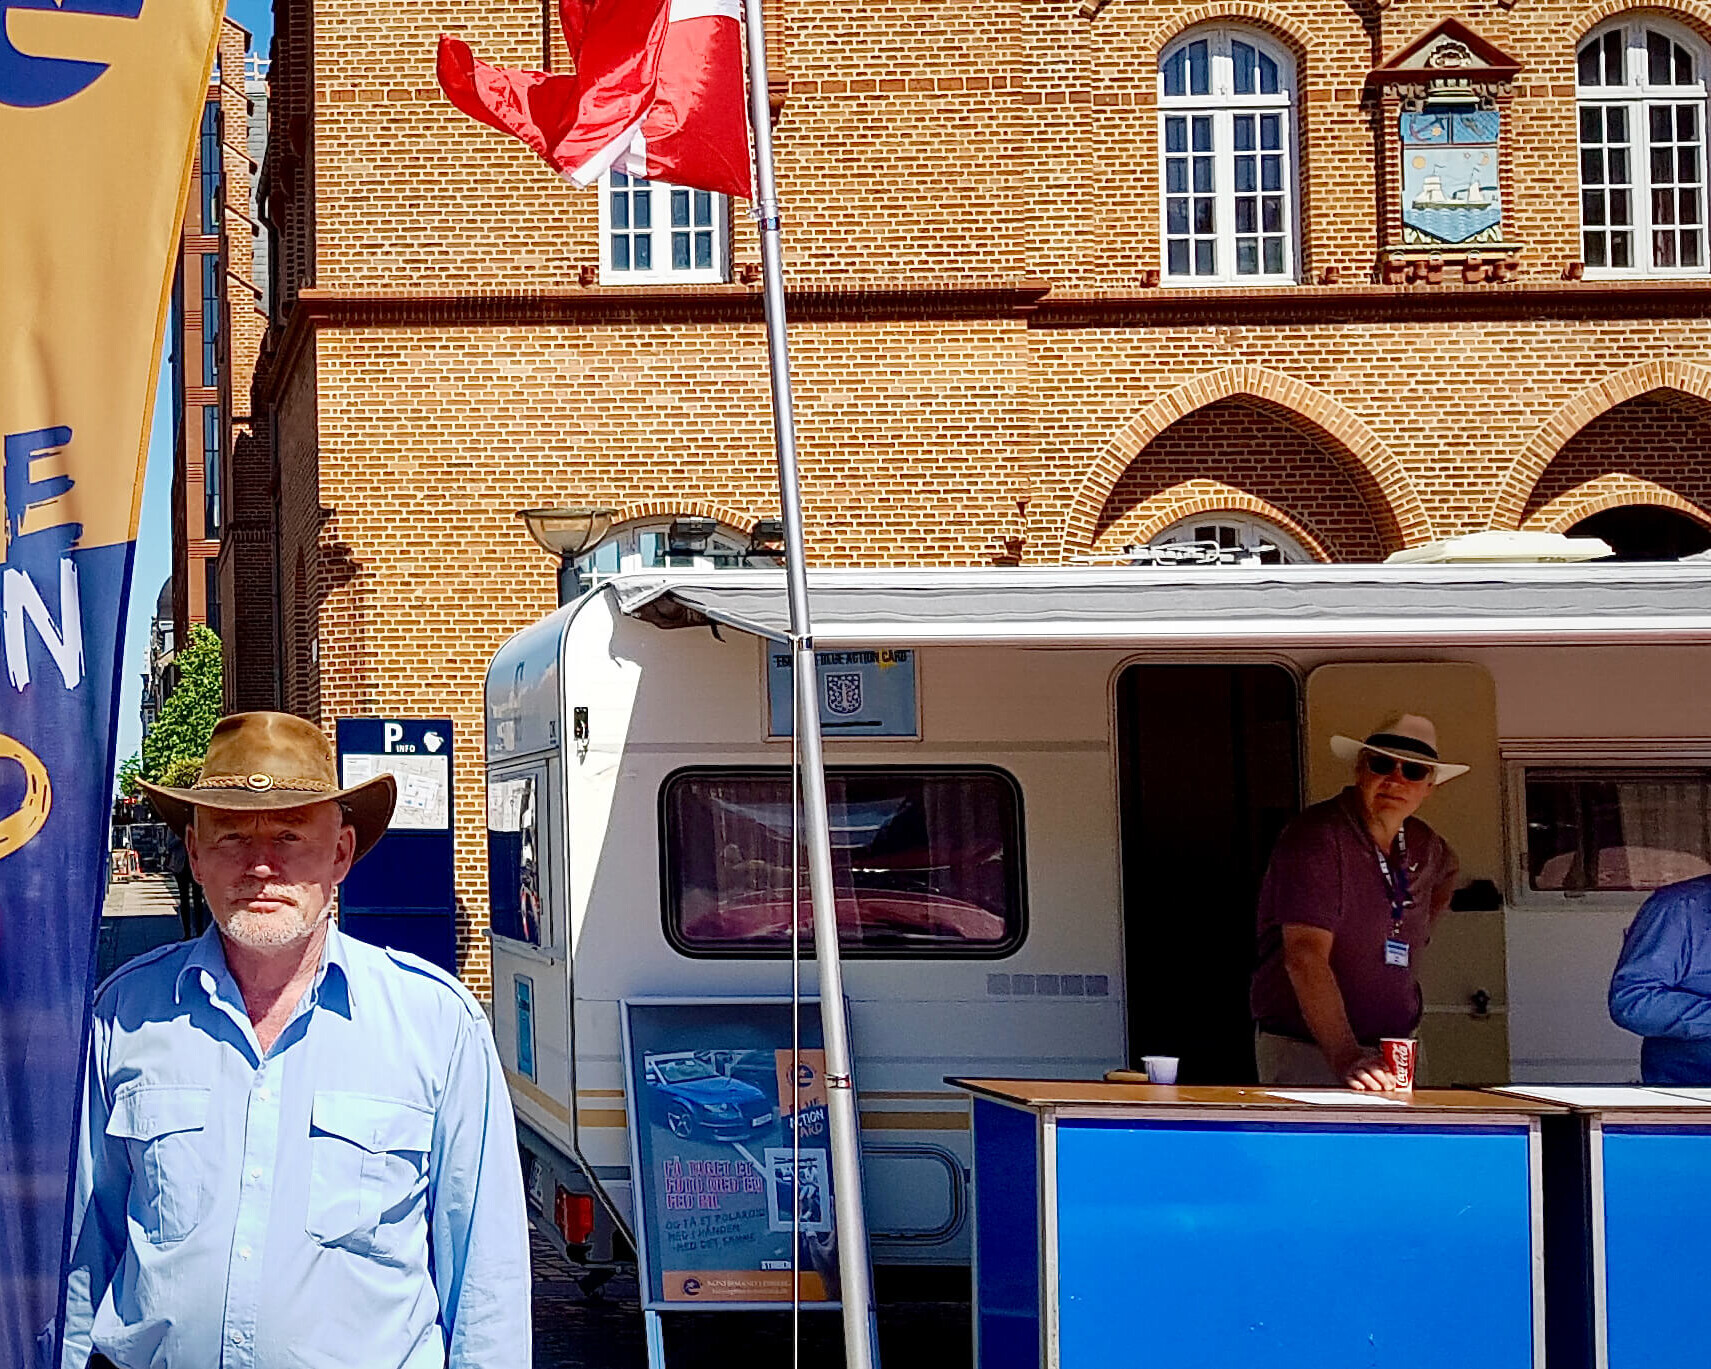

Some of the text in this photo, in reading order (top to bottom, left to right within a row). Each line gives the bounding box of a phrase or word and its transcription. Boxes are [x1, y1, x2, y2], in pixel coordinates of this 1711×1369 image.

[847, 651, 879, 665] ACTION
[882, 650, 908, 663] CARD
[384, 722, 416, 753] P INFO
